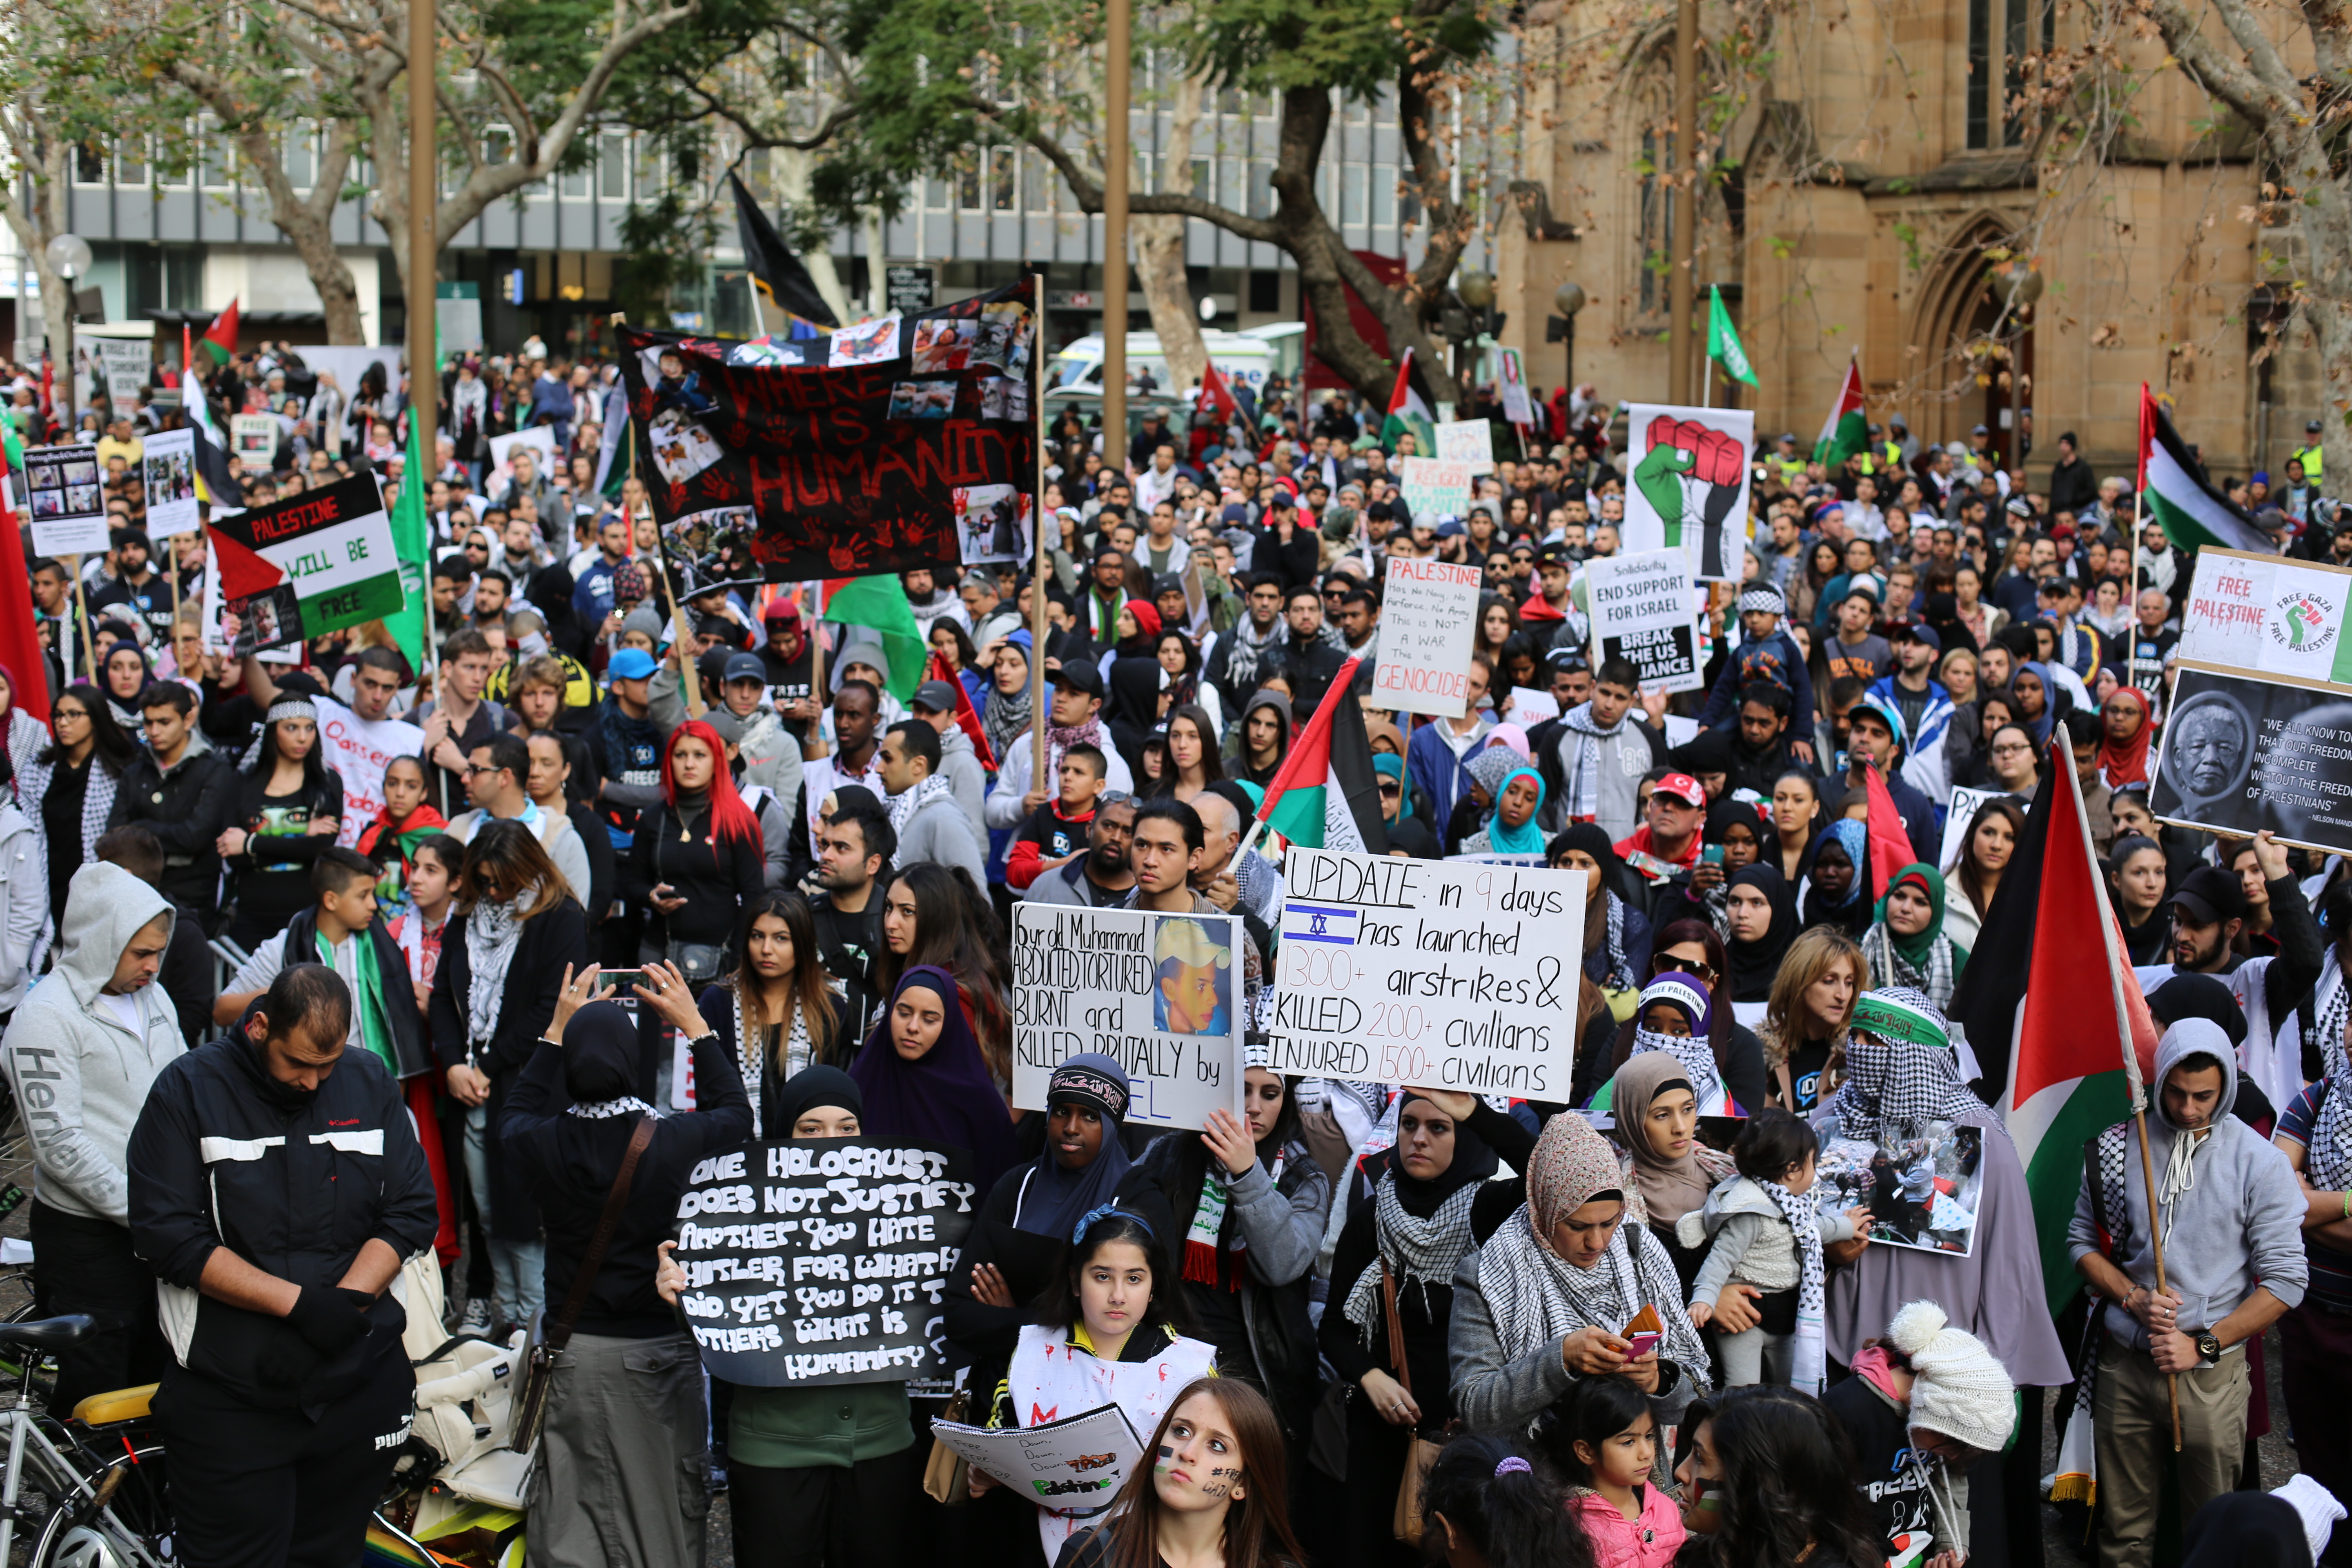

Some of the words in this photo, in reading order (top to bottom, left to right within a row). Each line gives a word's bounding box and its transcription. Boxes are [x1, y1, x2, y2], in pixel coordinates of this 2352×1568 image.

[722, 365, 889, 416] WHERE
[808, 406, 871, 450] IS
[748, 417, 1018, 512] HUMANITY
[250, 495, 340, 543] PALESTINE
[285, 549, 334, 579] WILL
[346, 537, 369, 562] BE
[1391, 559, 1481, 588] PALESTINE
[1614, 560, 1666, 577] Solidarity
[1388, 582, 1407, 594] Has
[1411, 585, 1422, 595] No
[1454, 592, 1466, 602] No
[1597, 585, 1623, 602] END
[1626, 575, 1684, 599] SUPPORT
[2216, 576, 2253, 597] FREE
[2276, 592, 2302, 610] FREE
[2307, 593, 2334, 612] GAZA
[318, 590, 363, 621] FREE
[1390, 612, 1411, 627] This
[1419, 619, 1427, 628] is
[1435, 618, 1460, 630] NOT
[1431, 603, 1444, 613] No
[1607, 606, 1632, 621] FOR
[1636, 599, 1680, 617] ISRAEL
[2193, 598, 2266, 626] PALESTINE
[1400, 633, 1409, 645] A
[1418, 635, 1446, 648] WAR
[1620, 627, 1675, 650] BREAK
[1655, 643, 1678, 661] US
[2270, 621, 2287, 646] FREE
[2288, 625, 2337, 653] PALESTINE
[1391, 648, 1412, 660] This
[1423, 652, 1432, 662] is
[1375, 664, 1469, 699] GENOCIDE!
[2258, 735, 2283, 751] THAT
[2286, 739, 2307, 753] OUR
[2284, 722, 2303, 735] ALL
[2305, 725, 2336, 740] KNOW
[2254, 752, 2318, 774] INCOMPLETE
[2247, 786, 2261, 800] OF
[2251, 769, 2297, 788] WIHTOUT
[2298, 777, 2317, 791] THE
[1951, 791, 1979, 822] PA
[2312, 814, 2335, 824] NELSON
[1291, 852, 1429, 908] UPDATE:
[1439, 883, 1462, 909] in
[1475, 871, 1493, 911] 9
[1501, 871, 1563, 918] days
[1071, 913, 1146, 954] Muhammad
[1357, 909, 1403, 947] has
[1415, 918, 1522, 957] launched
[1078, 950, 1155, 996] TORTURED
[1283, 944, 1366, 991] 1300+
[1388, 962, 1530, 1003] airstrikes
[1535, 956, 1563, 1011] &
[1649, 985, 1666, 996] FREE
[1013, 987, 1075, 1027] BURNT
[1085, 997, 1123, 1033] and
[1276, 991, 1362, 1034] KILLED
[1366, 1002, 1433, 1040] 200+
[1446, 1009, 1551, 1053] civilians
[1017, 1028, 1083, 1069] KILLED
[1197, 1044, 1221, 1088] by
[1267, 1035, 1369, 1074] INJURED
[1378, 1044, 1435, 1081] 1500+
[1442, 1055, 1547, 1092] civilians
[16, 1047, 116, 1205] Henleys
[689, 1152, 747, 1185] ONE
[766, 1145, 948, 1180] HOLOCAUST
[677, 1184, 756, 1218] DOES
[764, 1186, 829, 1214] NOT
[801, 1217, 857, 1251] YOU
[867, 1215, 935, 1247] HATE
[678, 1255, 786, 1288] HITLER
[793, 1253, 850, 1282] FOR
[853, 1252, 939, 1281] WHAT
[730, 1290, 788, 1324] YET
[795, 1286, 846, 1316] YOU
[851, 1283, 883, 1307] DO
[891, 1281, 916, 1304] IT
[921, 1278, 946, 1305] T
[692, 1324, 783, 1353] OTHERS
[792, 1312, 871, 1343] WHAT
[1019, 1439, 1051, 1448] Down,
